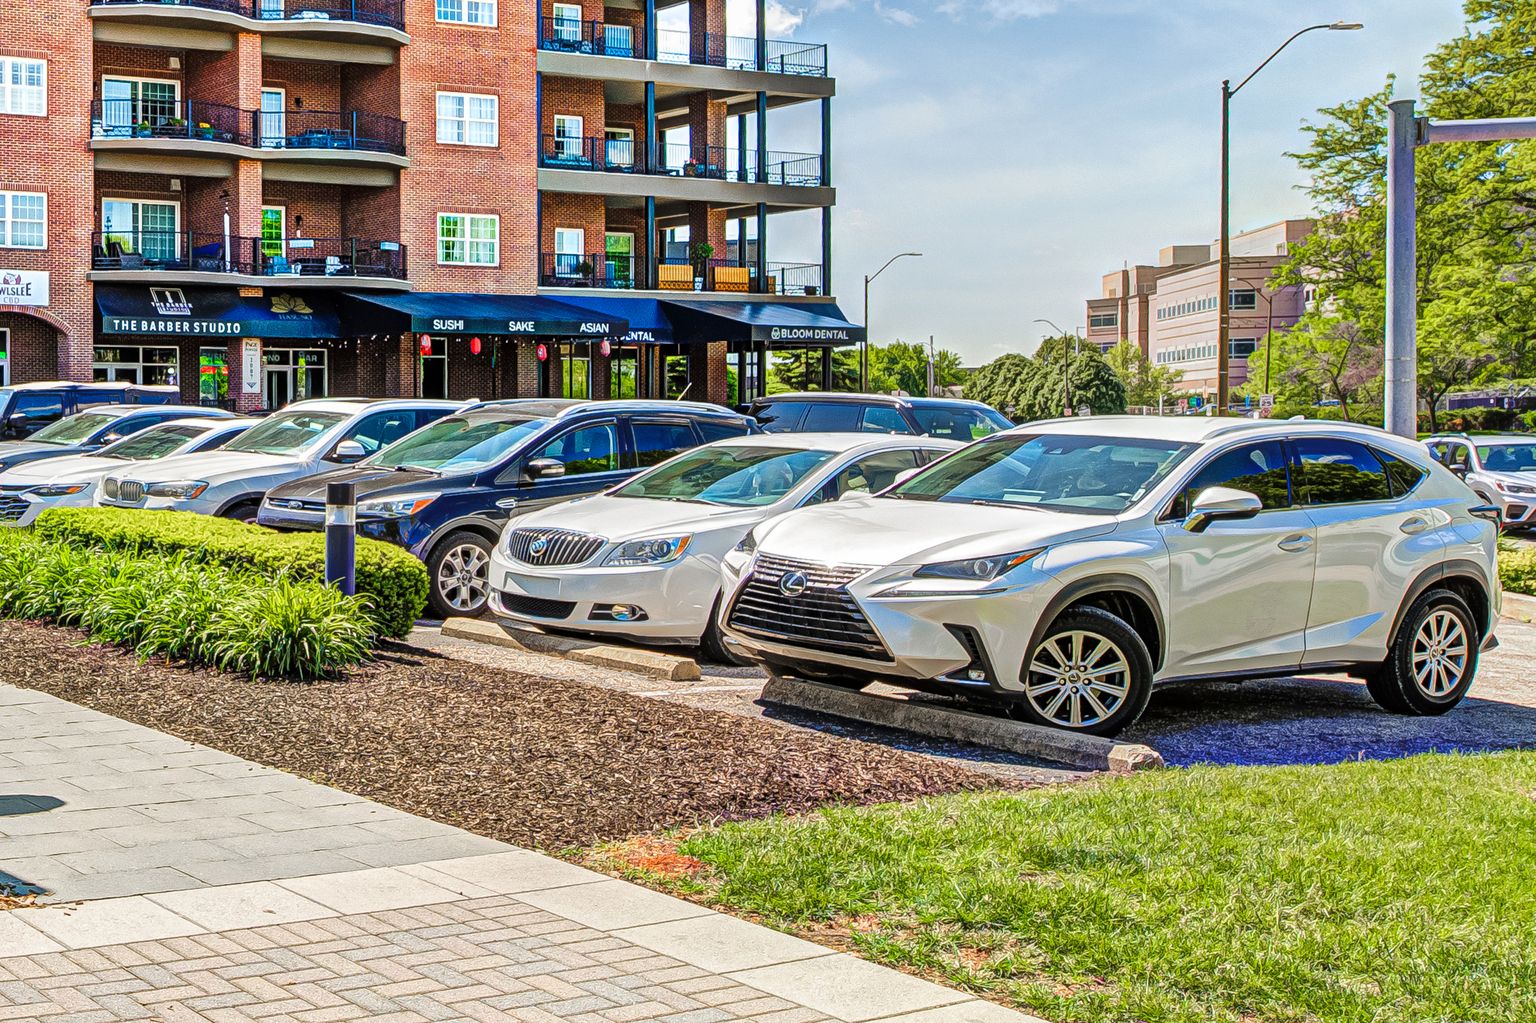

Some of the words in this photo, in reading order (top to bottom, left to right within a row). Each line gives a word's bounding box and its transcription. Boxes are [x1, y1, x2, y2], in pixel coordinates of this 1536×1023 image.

[113, 320, 137, 331] THE
[141, 321, 190, 332] BARBER
[193, 322, 241, 334] STUDIO
[433, 319, 464, 331] SUSHI
[509, 321, 535, 332] SAKE
[580, 322, 609, 334] ASIAN
[781, 329, 813, 339] BLOOM
[814, 330, 849, 340] DENTAL
